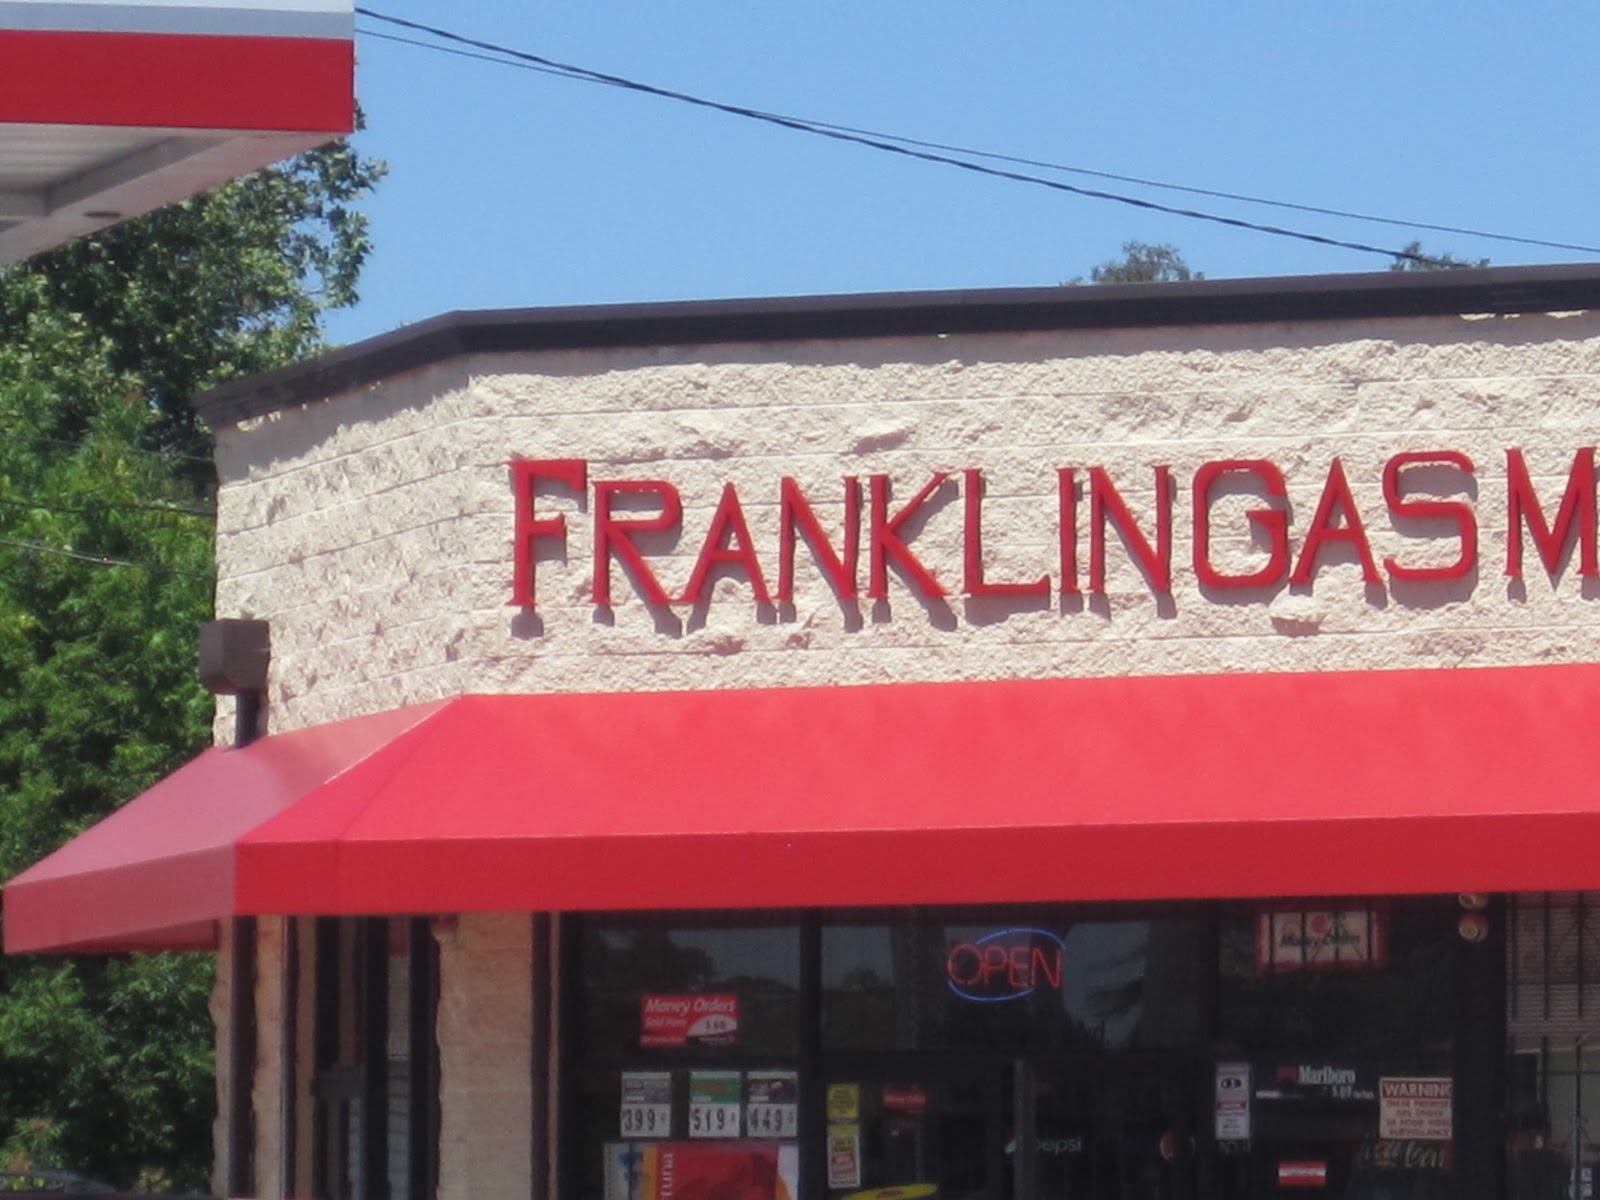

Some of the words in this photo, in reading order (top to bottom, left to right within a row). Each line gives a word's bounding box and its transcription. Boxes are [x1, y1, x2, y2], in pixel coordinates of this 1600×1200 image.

[946, 943, 1065, 988] OPEN
[646, 999, 690, 1017] Money
[693, 998, 735, 1012] Orders
[1298, 1064, 1356, 1085] Marlboro
